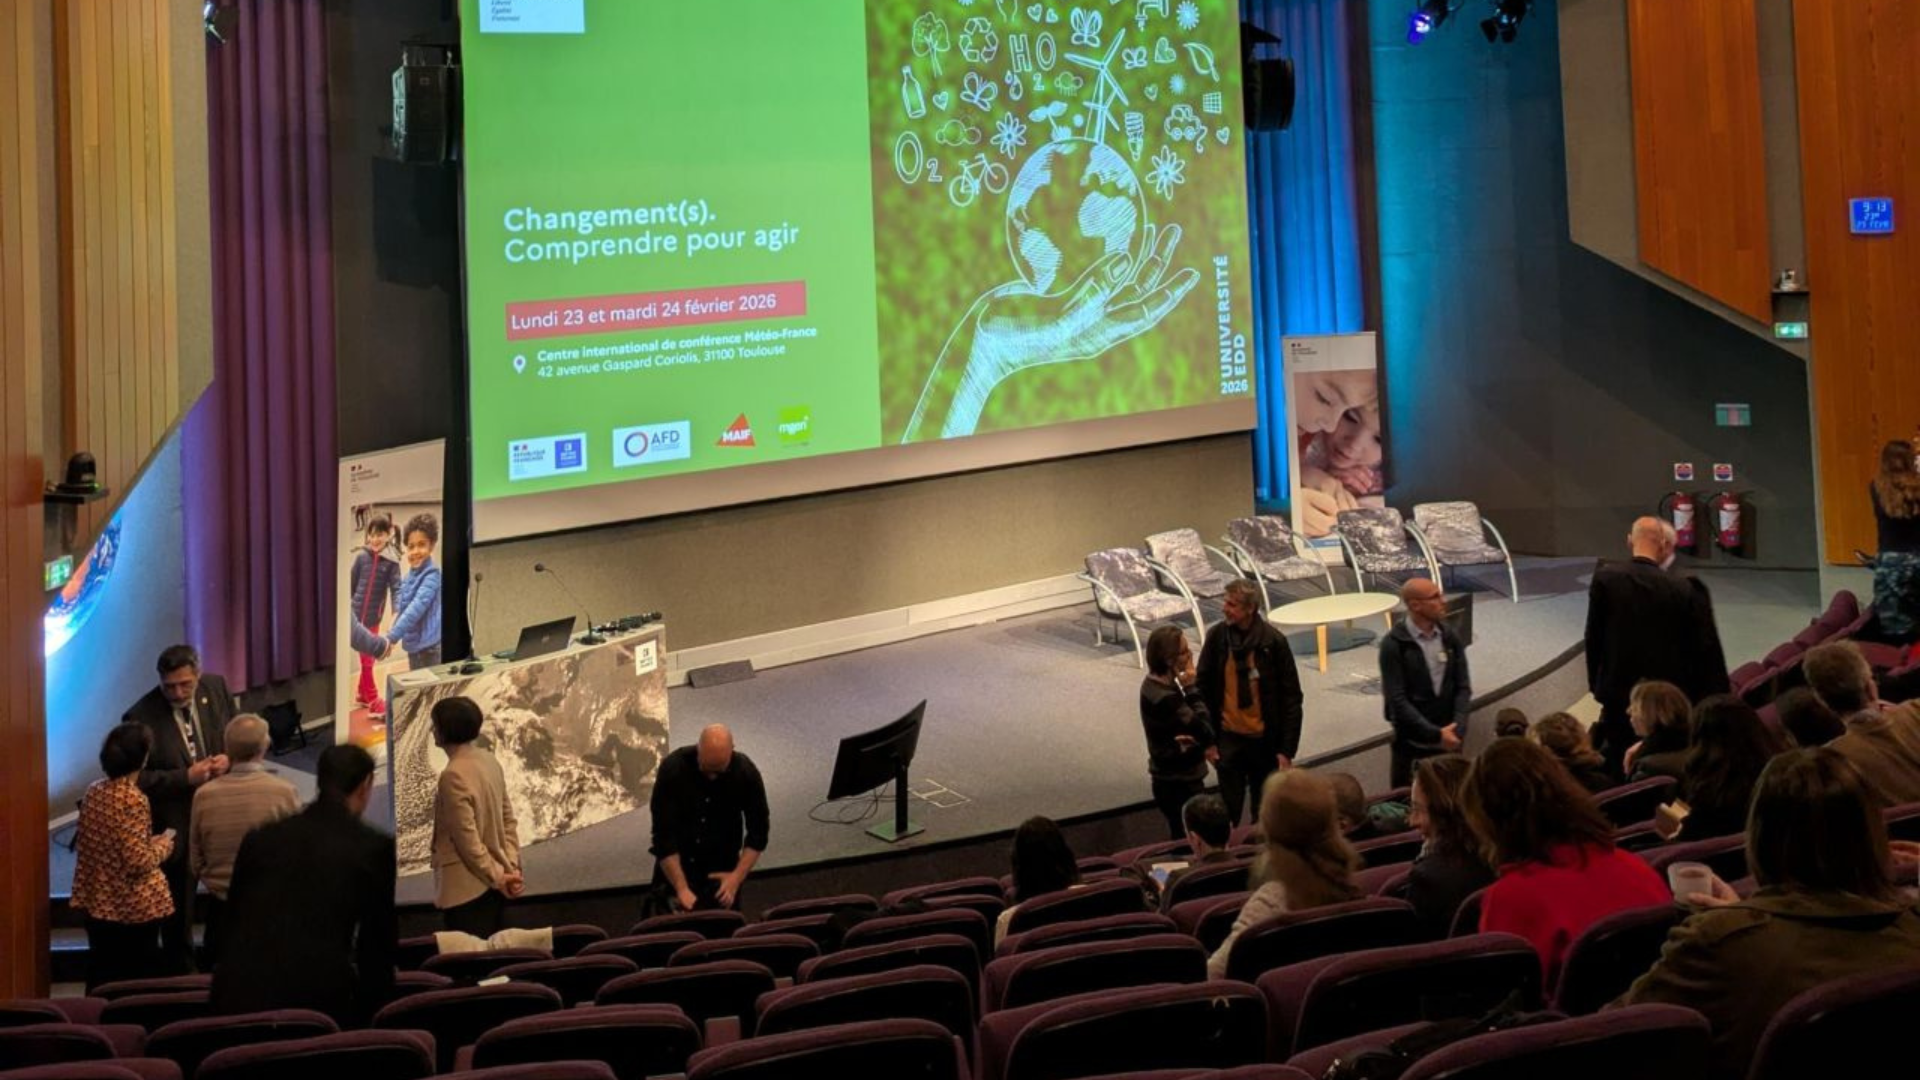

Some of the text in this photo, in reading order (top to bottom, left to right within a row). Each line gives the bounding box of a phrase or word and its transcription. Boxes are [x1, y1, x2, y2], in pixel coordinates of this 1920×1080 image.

[503, 200, 717, 233] Changement(s).
[504, 222, 800, 264] Comprendre pour agir
[511, 293, 777, 330] Lundi 23 et mardi 24 février 2026
[1213, 255, 1232, 378] UNIVERSITÉ
[537, 349, 580, 363] Centre
[661, 338, 677, 351] de
[679, 333, 742, 350] conférence
[744, 327, 818, 342] Météo-France
[537, 343, 787, 378] 42 avenue Gaspard Coriolis, 31100 Toulouse
[1233, 334, 1247, 376] EDD
[1220, 379, 1249, 394] 2026
[651, 430, 680, 444] AFD
[722, 428, 752, 442] MAIF
